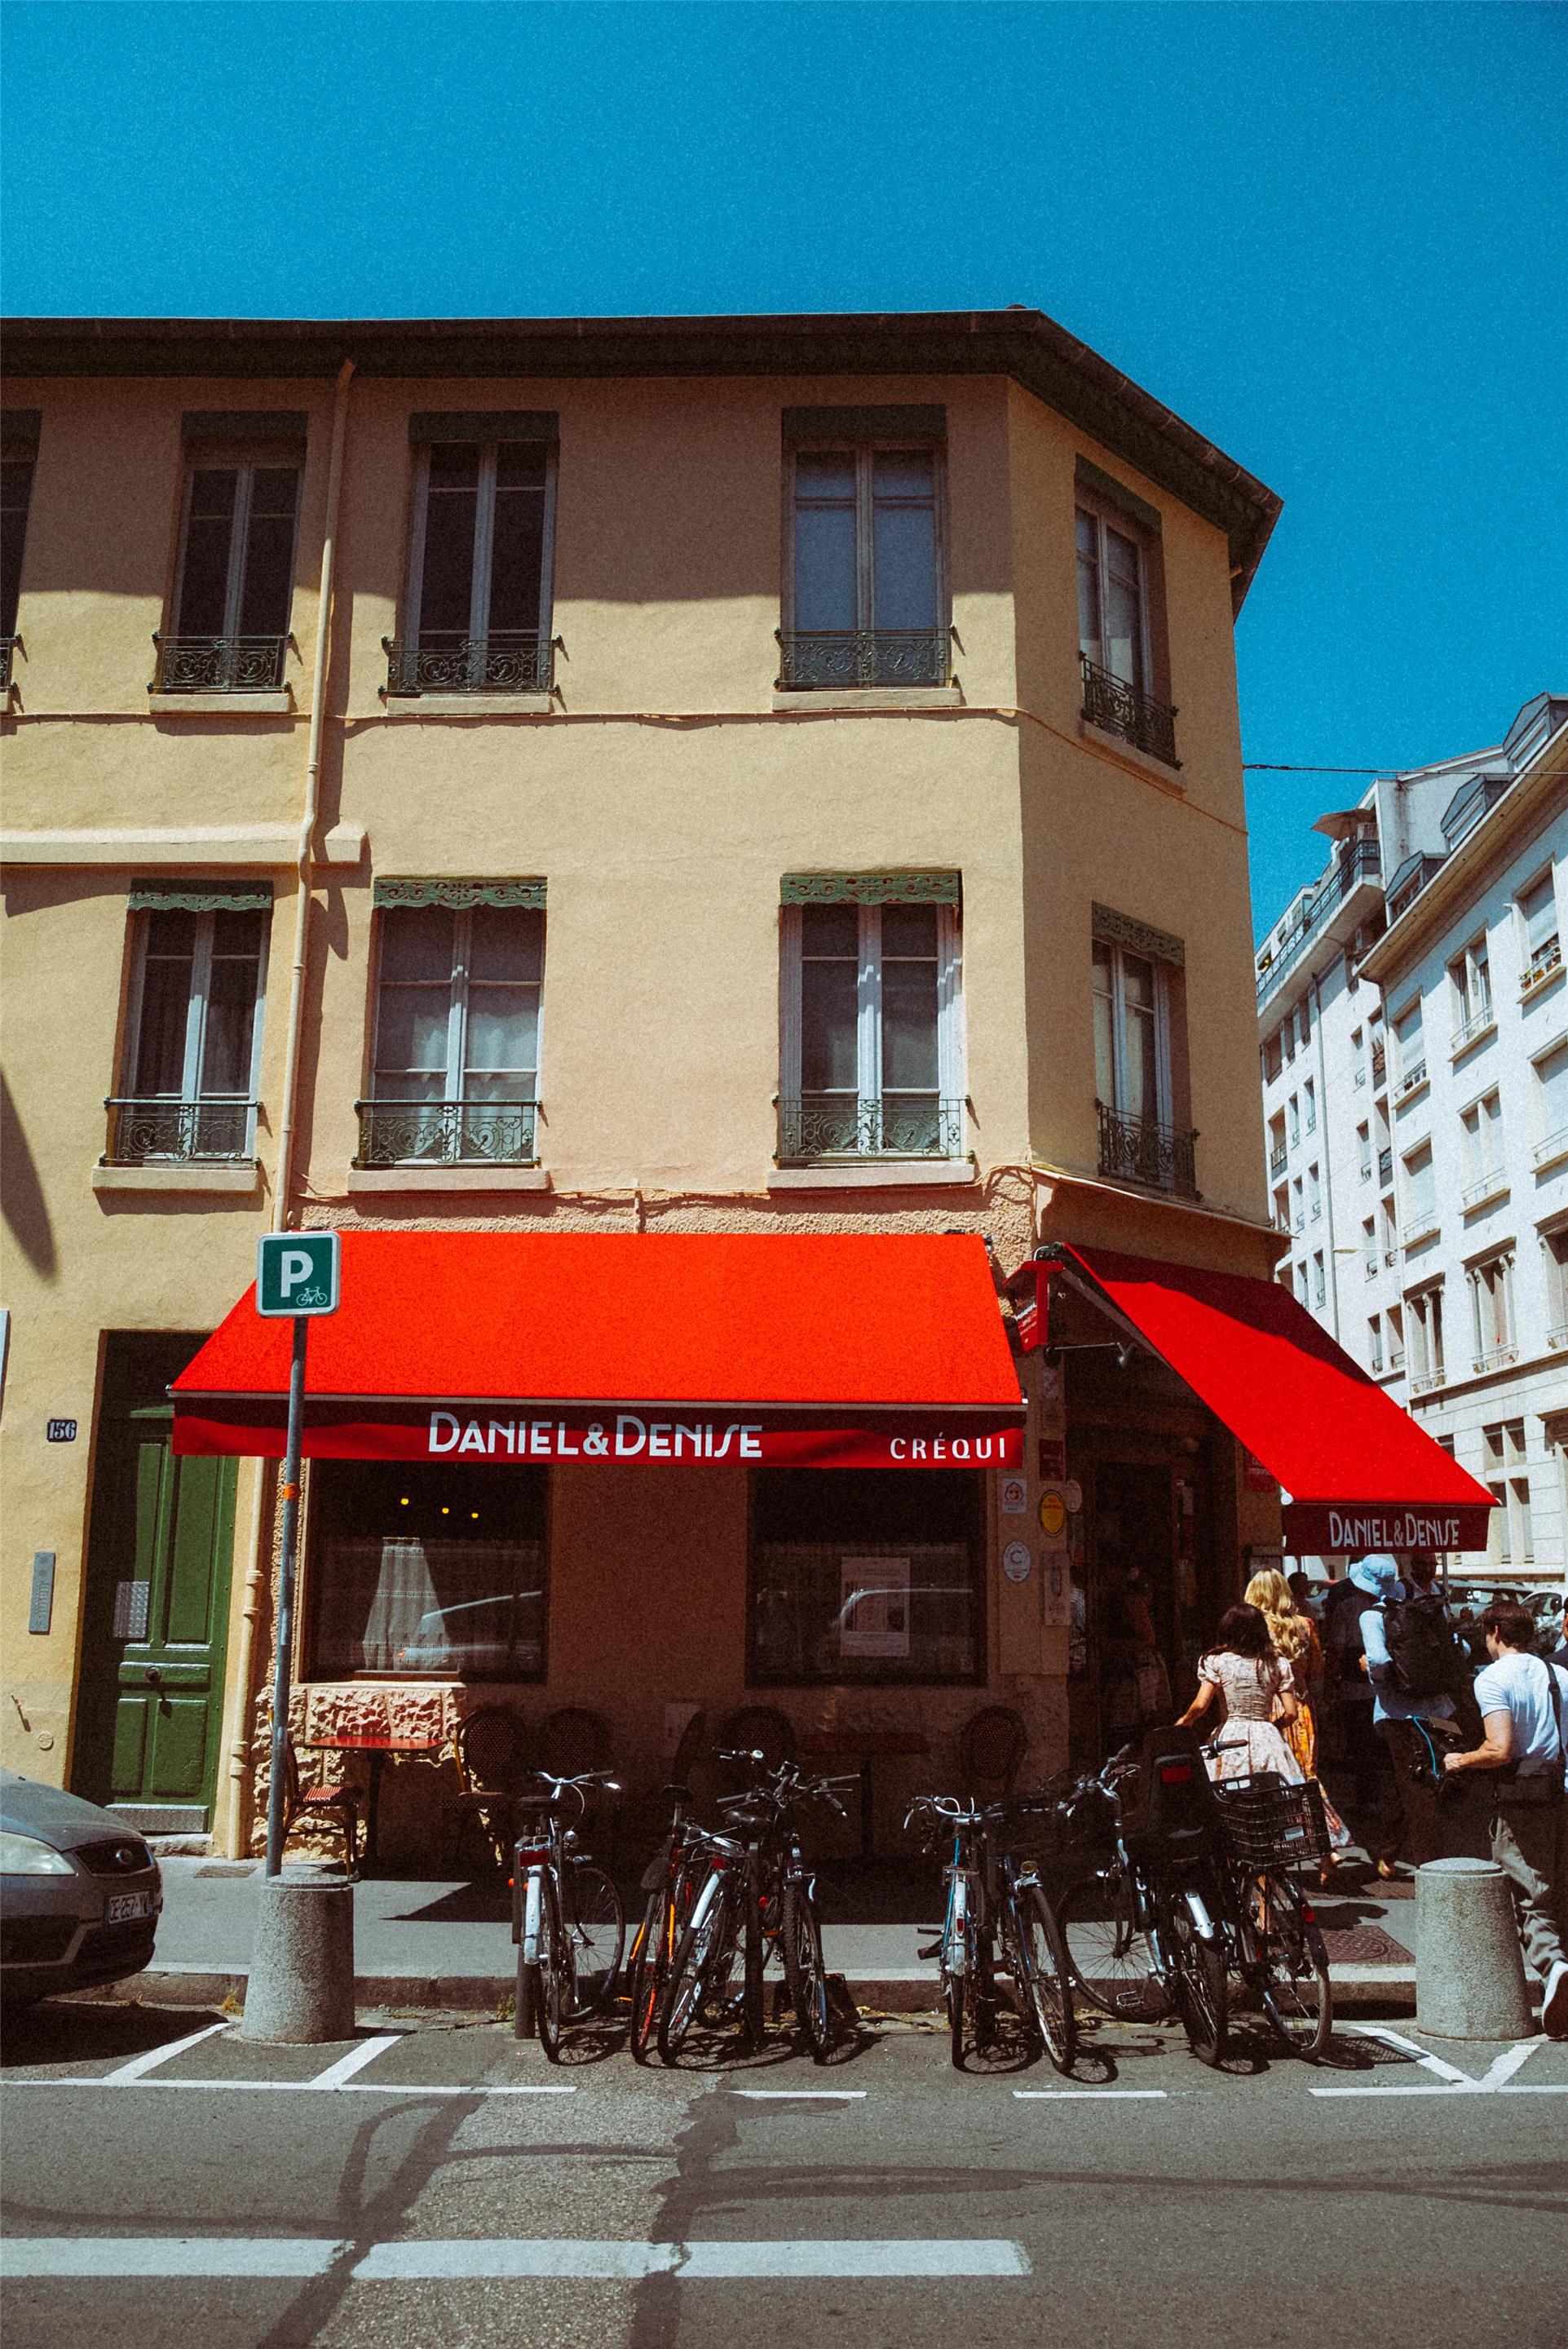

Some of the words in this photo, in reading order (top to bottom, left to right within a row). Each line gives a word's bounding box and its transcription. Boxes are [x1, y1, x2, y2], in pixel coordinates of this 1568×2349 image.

[280, 1250, 314, 1298] P
[49, 1422, 76, 1440] 156
[890, 1431, 1005, 1459] CRÉQUI
